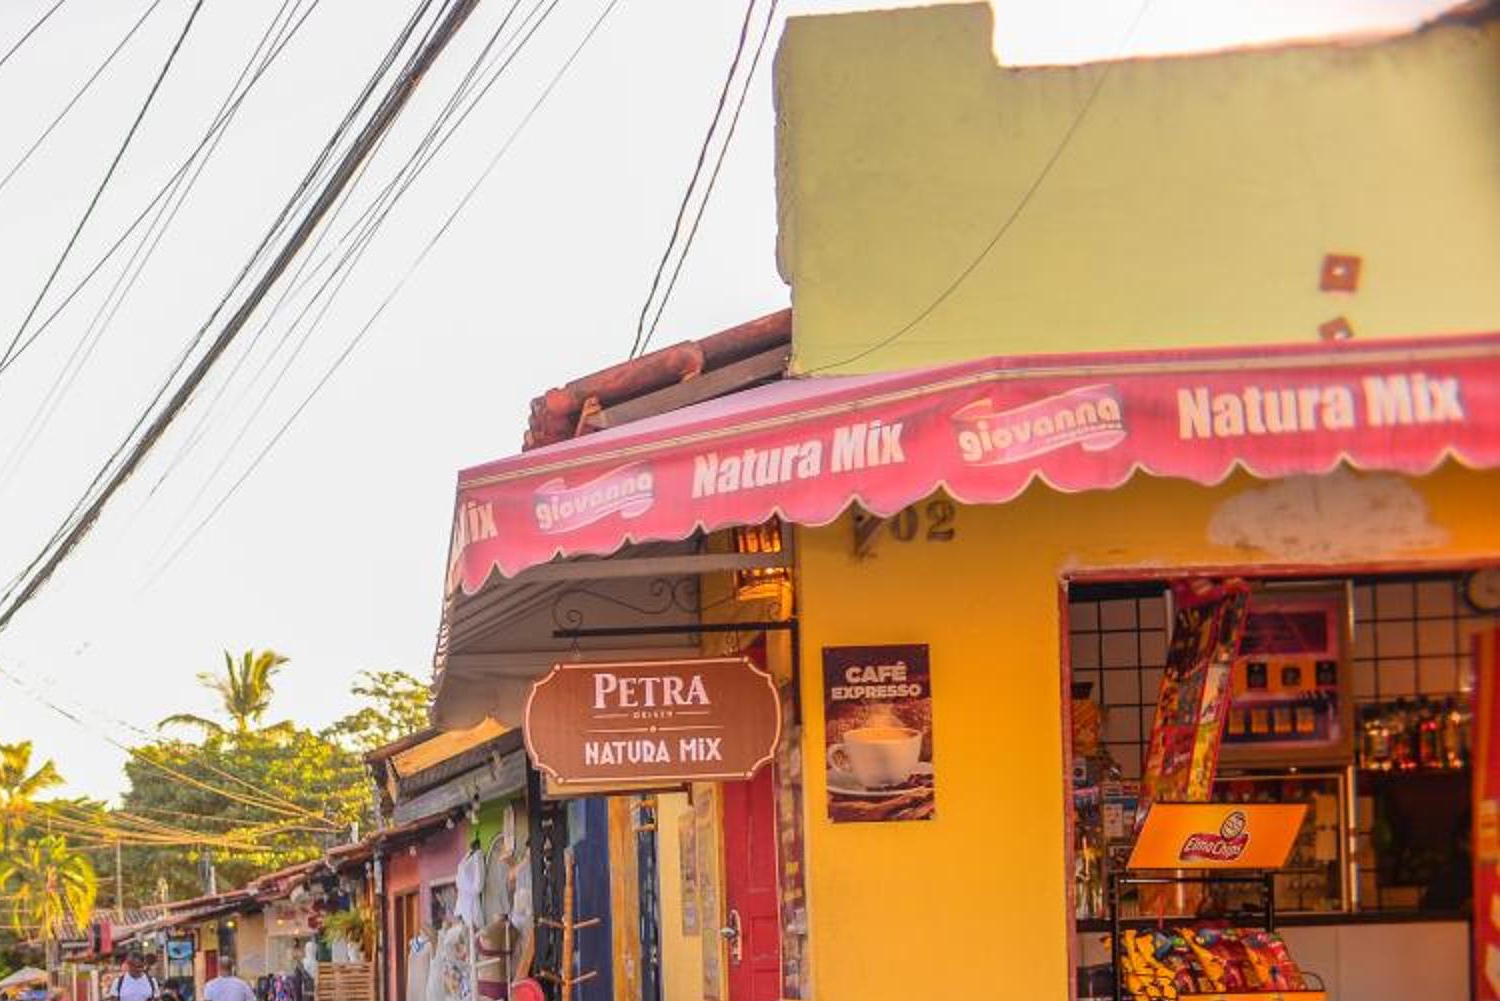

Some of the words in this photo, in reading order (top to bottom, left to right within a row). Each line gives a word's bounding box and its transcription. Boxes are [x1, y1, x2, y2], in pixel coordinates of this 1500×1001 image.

[958, 396, 1123, 463] giovanna
[1177, 384, 1355, 440] Natura
[1362, 372, 1465, 427] Mix
[691, 439, 823, 498] Natura
[830, 419, 906, 473] Mix
[536, 470, 652, 532] giovanna
[592, 672, 712, 709] PETRA
[831, 683, 922, 701] EXPRESSO
[845, 661, 908, 684] CAFÉ
[585, 740, 671, 766] NATURA
